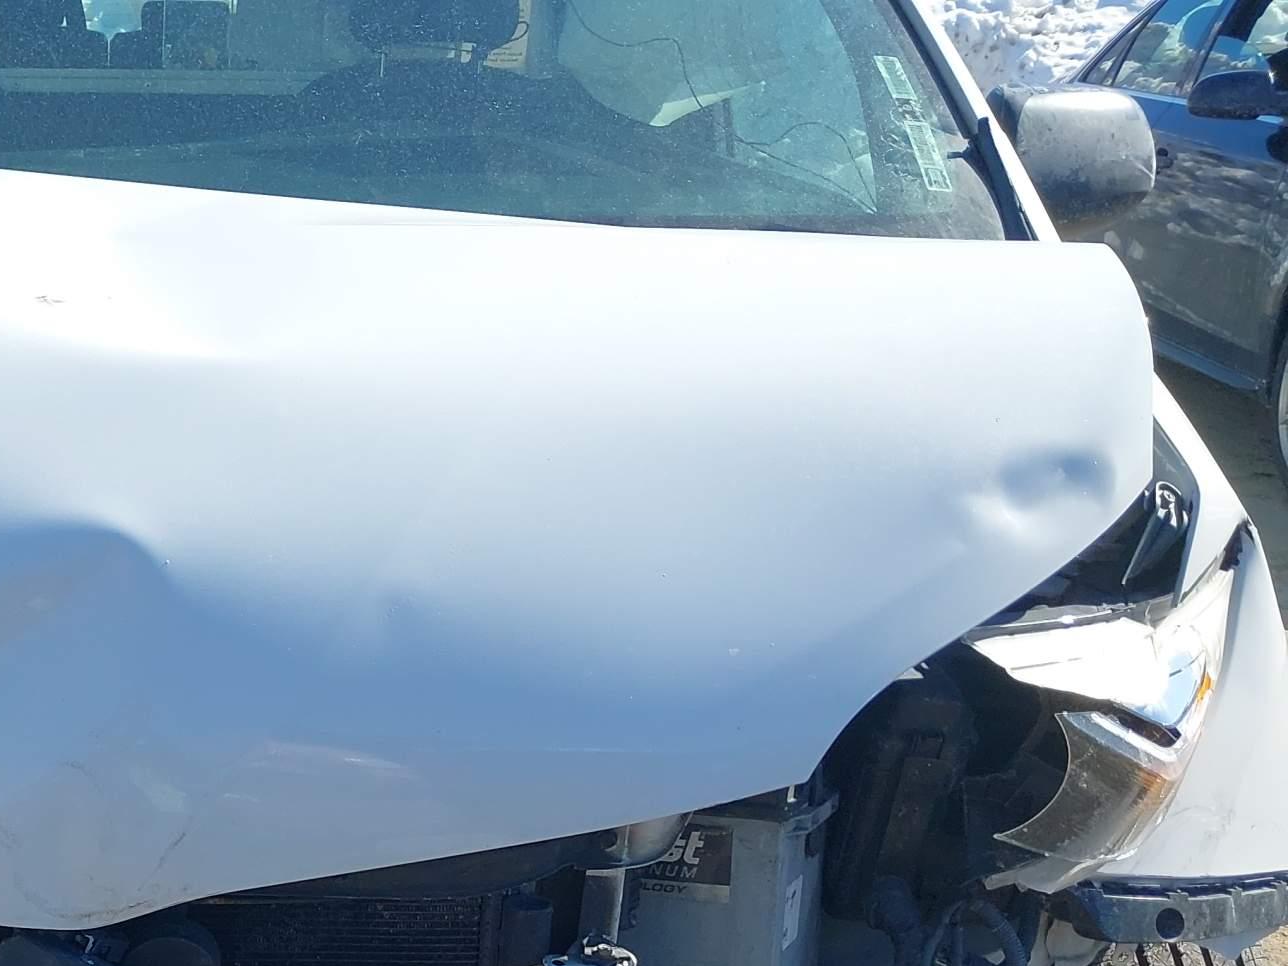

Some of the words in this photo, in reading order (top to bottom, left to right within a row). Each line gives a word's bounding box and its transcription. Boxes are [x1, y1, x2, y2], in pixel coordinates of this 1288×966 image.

[659, 831, 705, 865] st
[648, 863, 698, 879] NUM
[640, 881, 688, 894] LOGY
